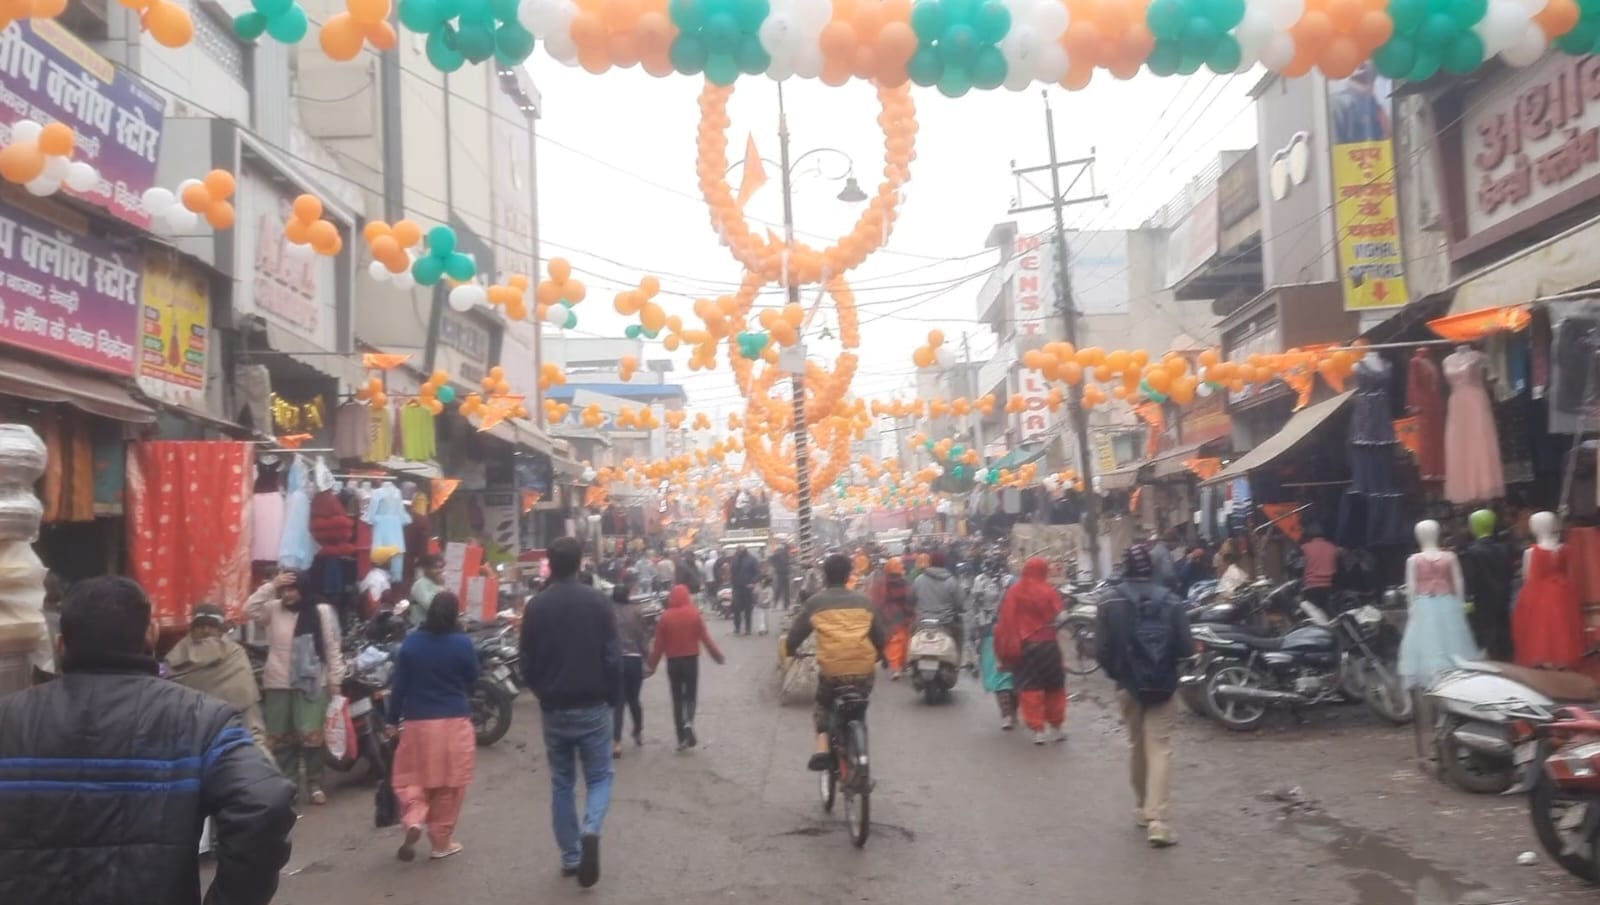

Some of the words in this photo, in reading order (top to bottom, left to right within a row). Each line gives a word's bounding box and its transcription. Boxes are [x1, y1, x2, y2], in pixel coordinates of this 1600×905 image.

[117, 108, 160, 163] स्टोर
[21, 225, 92, 287] क्लॉथ
[94, 252, 139, 305] स्टोर
